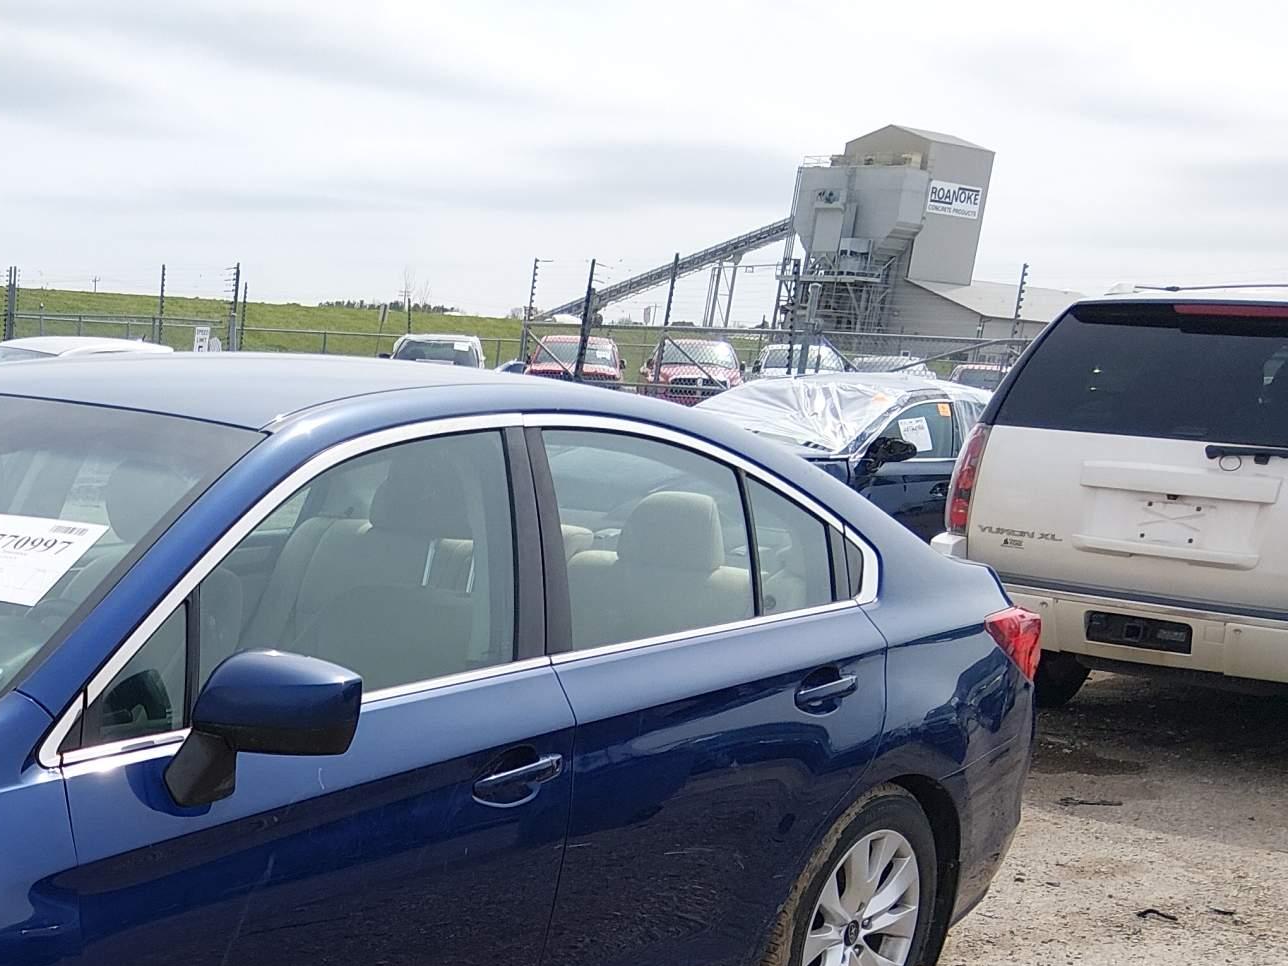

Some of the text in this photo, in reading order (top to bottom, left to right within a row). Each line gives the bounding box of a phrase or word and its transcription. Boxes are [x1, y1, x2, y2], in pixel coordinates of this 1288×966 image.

[930, 186, 979, 205] ROANOKE
[928, 204, 977, 217] CONCRETE PRODUCTS
[977, 525, 1063, 542] YUKON XL
